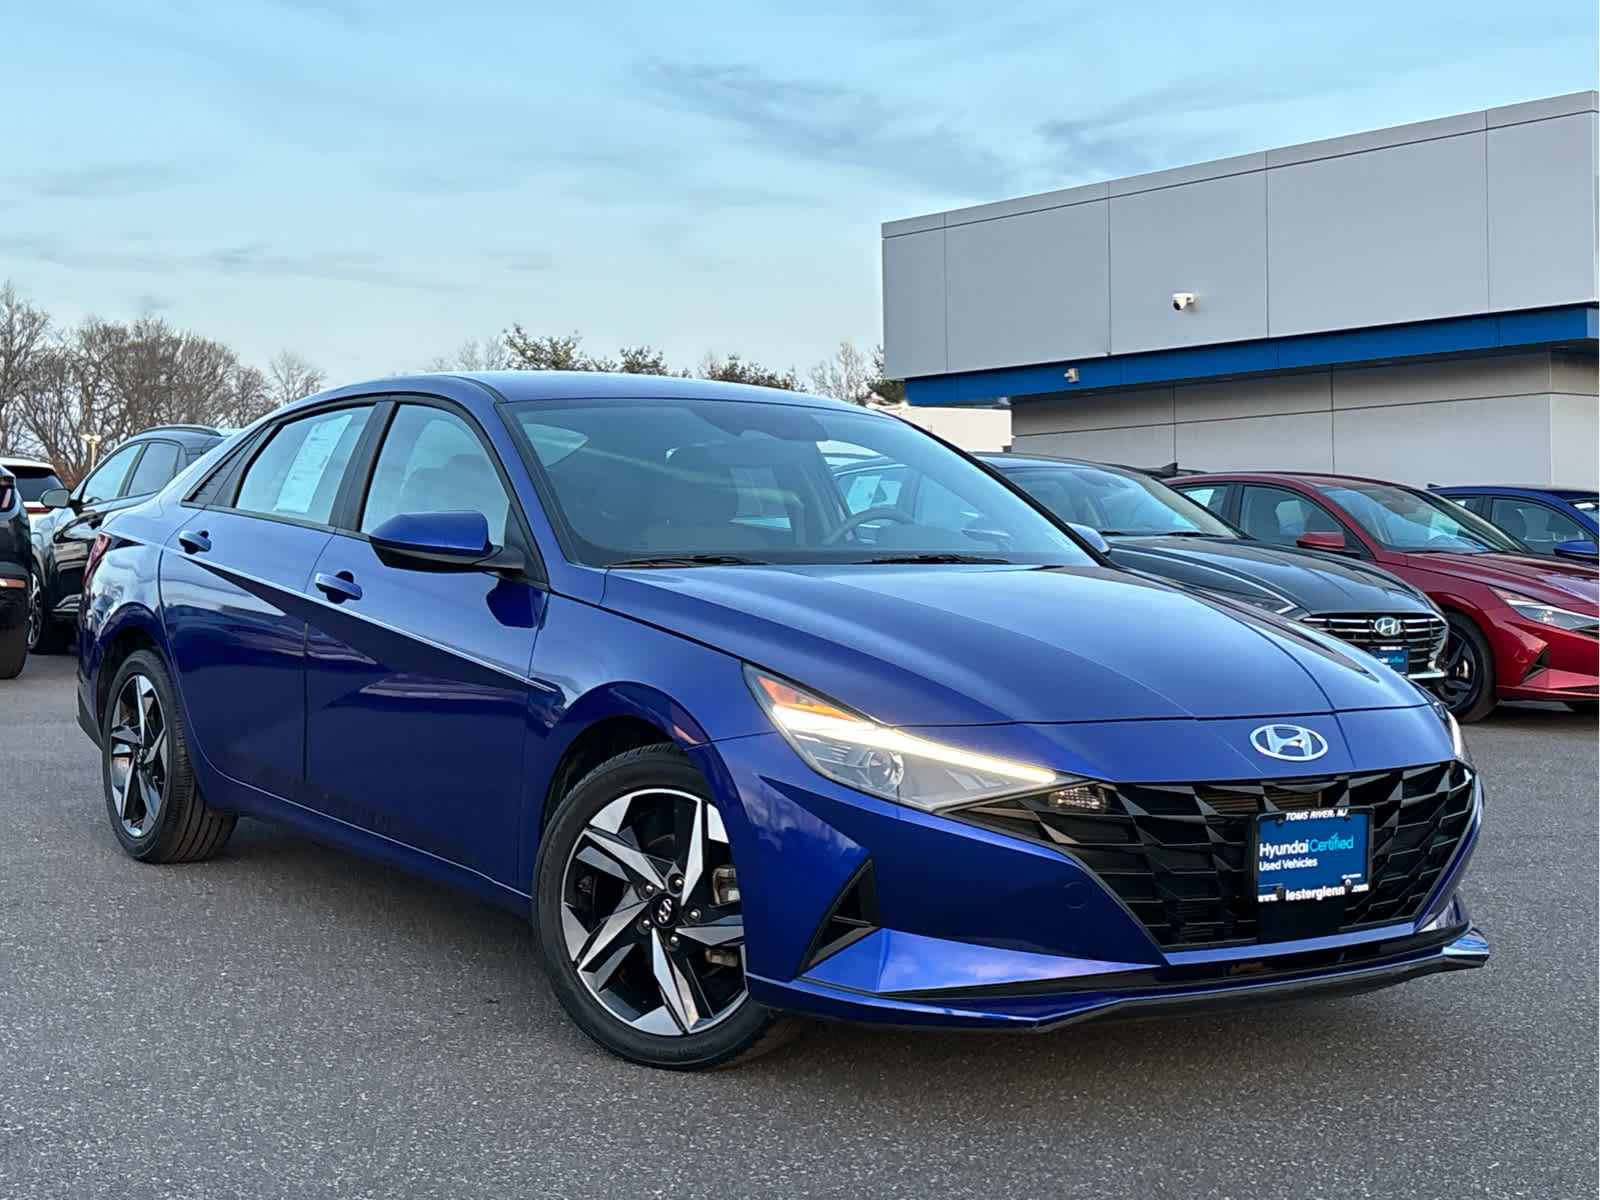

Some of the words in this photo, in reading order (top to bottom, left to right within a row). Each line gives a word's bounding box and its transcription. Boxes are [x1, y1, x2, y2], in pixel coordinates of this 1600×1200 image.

[1285, 811, 1309, 821] TOMS
[1259, 861, 1281, 871] Used
[1282, 857, 1318, 869] Vehicles
